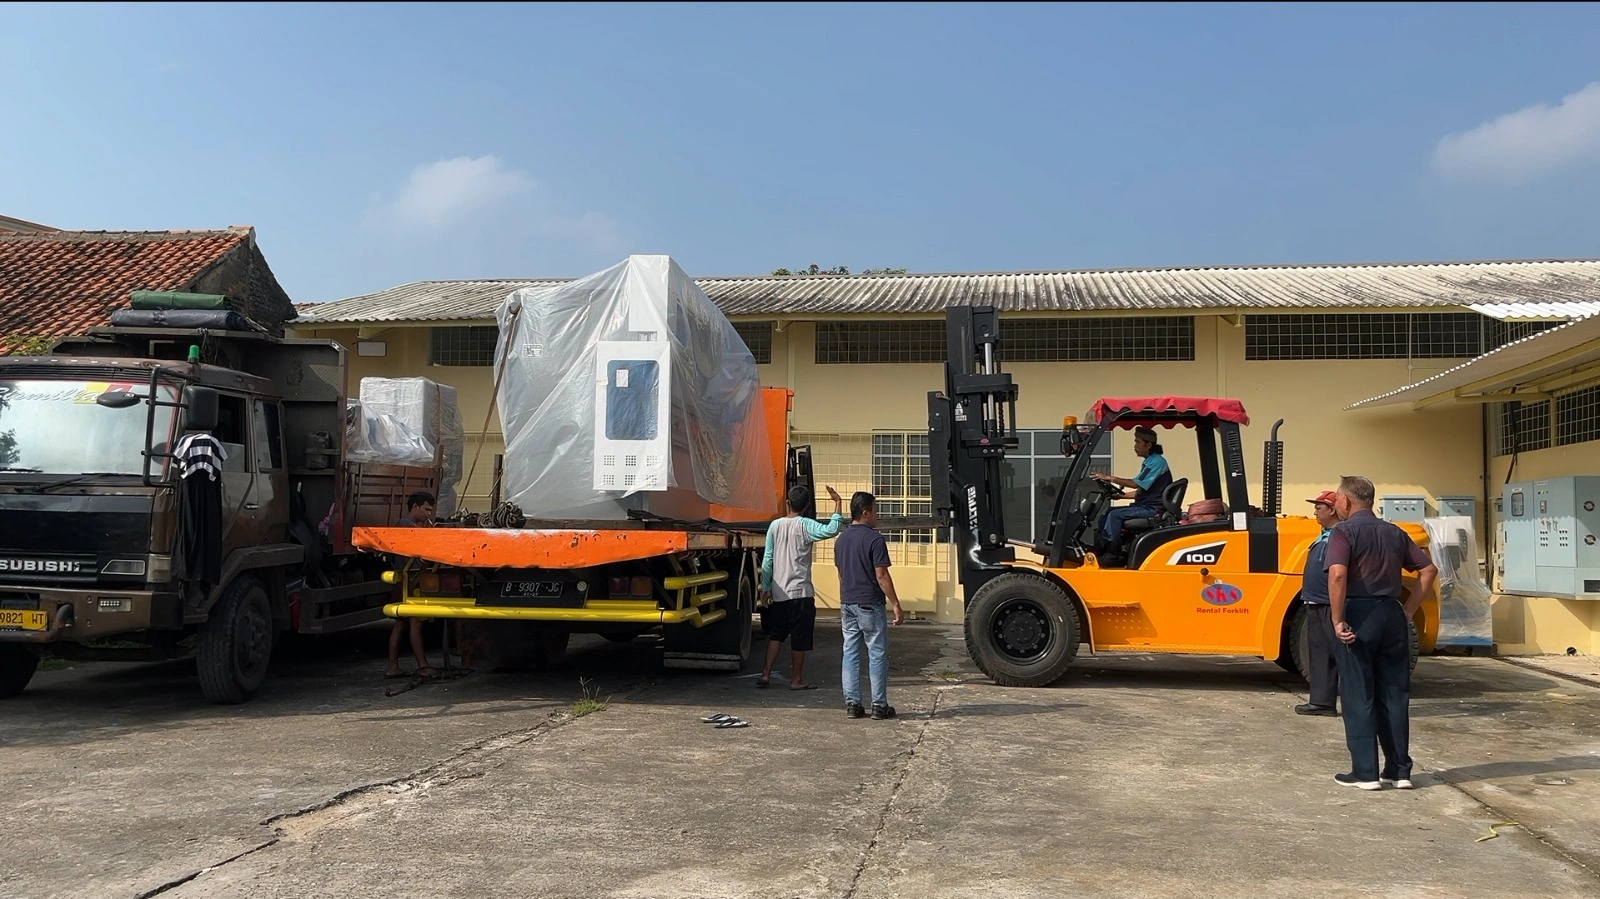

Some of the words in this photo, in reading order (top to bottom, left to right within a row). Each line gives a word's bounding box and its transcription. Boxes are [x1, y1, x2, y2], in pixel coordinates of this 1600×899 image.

[1186, 554, 1215, 563] 100
[505, 582, 513, 592] B
[519, 582, 541, 592] 9307
[0, 612, 24, 624] 9821
[32, 613, 44, 625] WT
